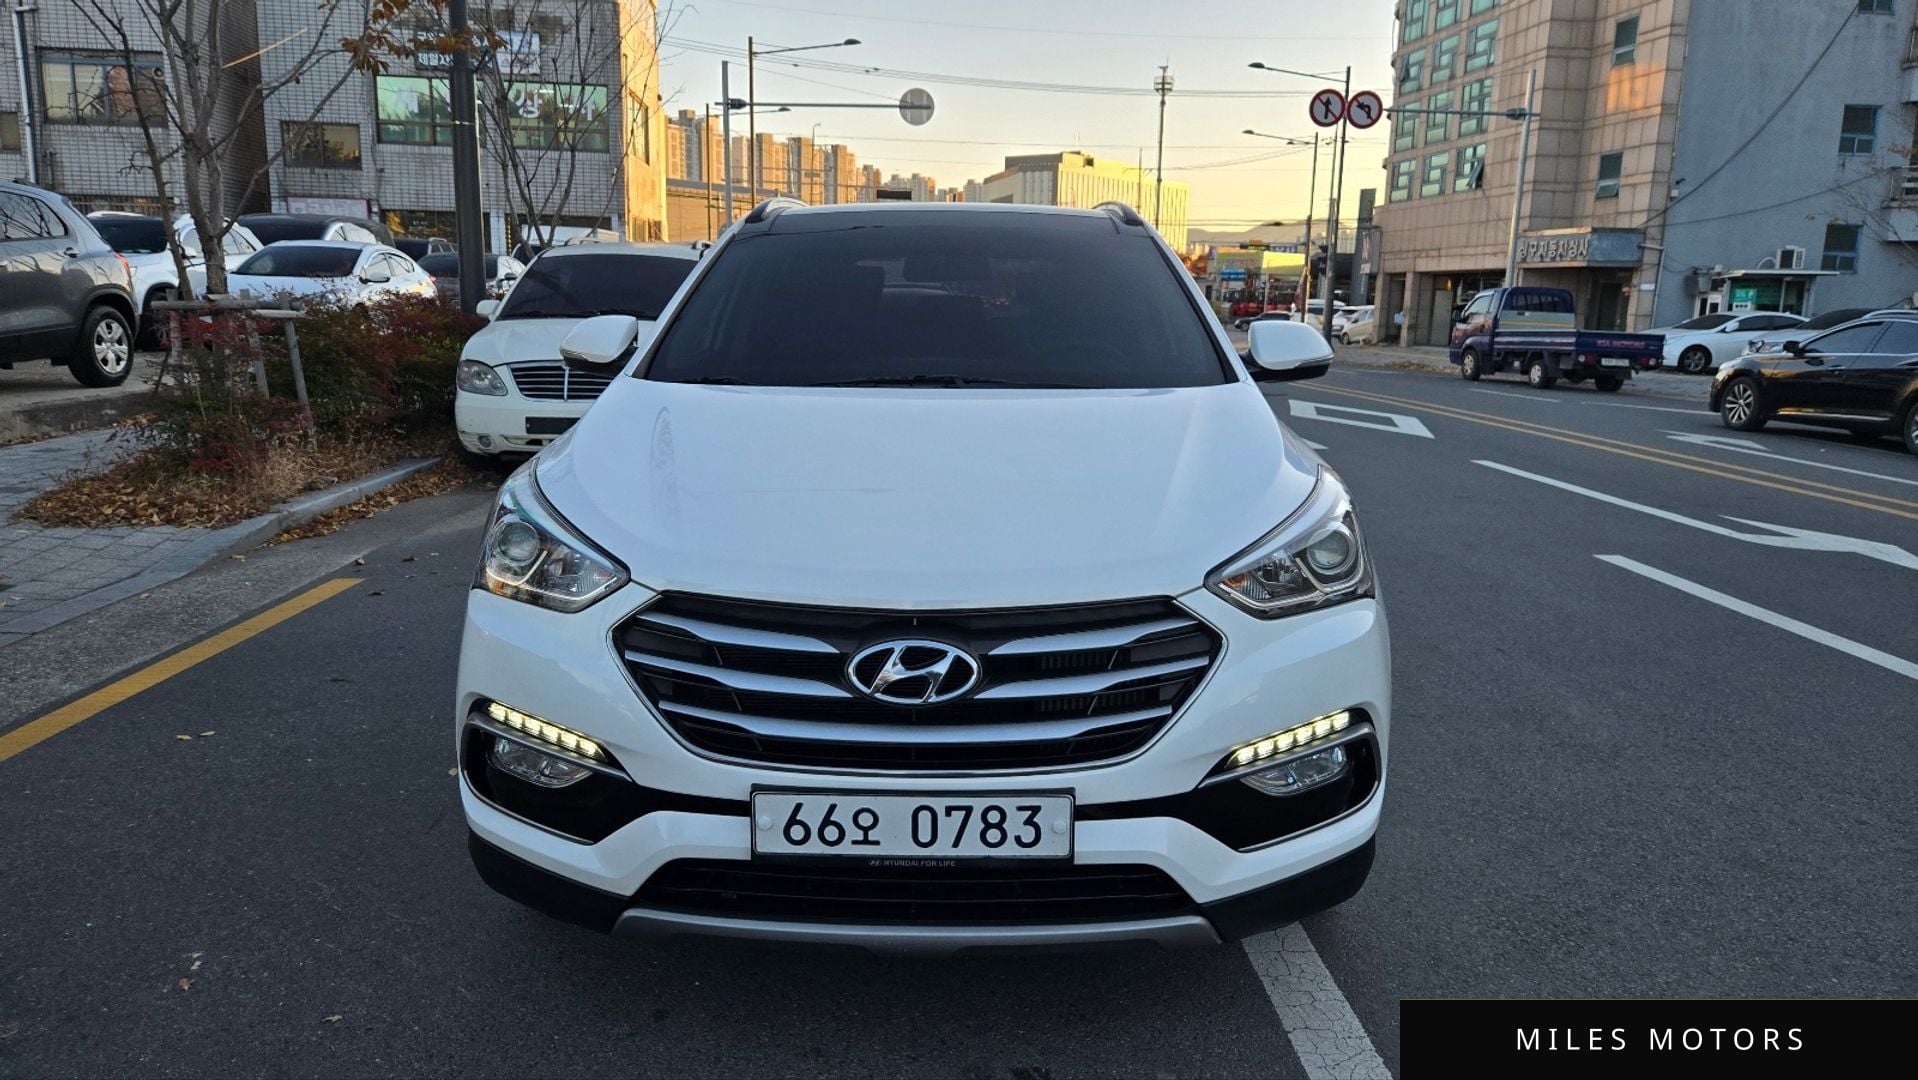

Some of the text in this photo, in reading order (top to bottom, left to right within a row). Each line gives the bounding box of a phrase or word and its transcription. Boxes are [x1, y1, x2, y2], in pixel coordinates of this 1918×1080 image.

[782, 802, 1042, 849] 66오 0783
[883, 859, 919, 867] HYUNDAI
[920, 859, 937, 867] FOR
